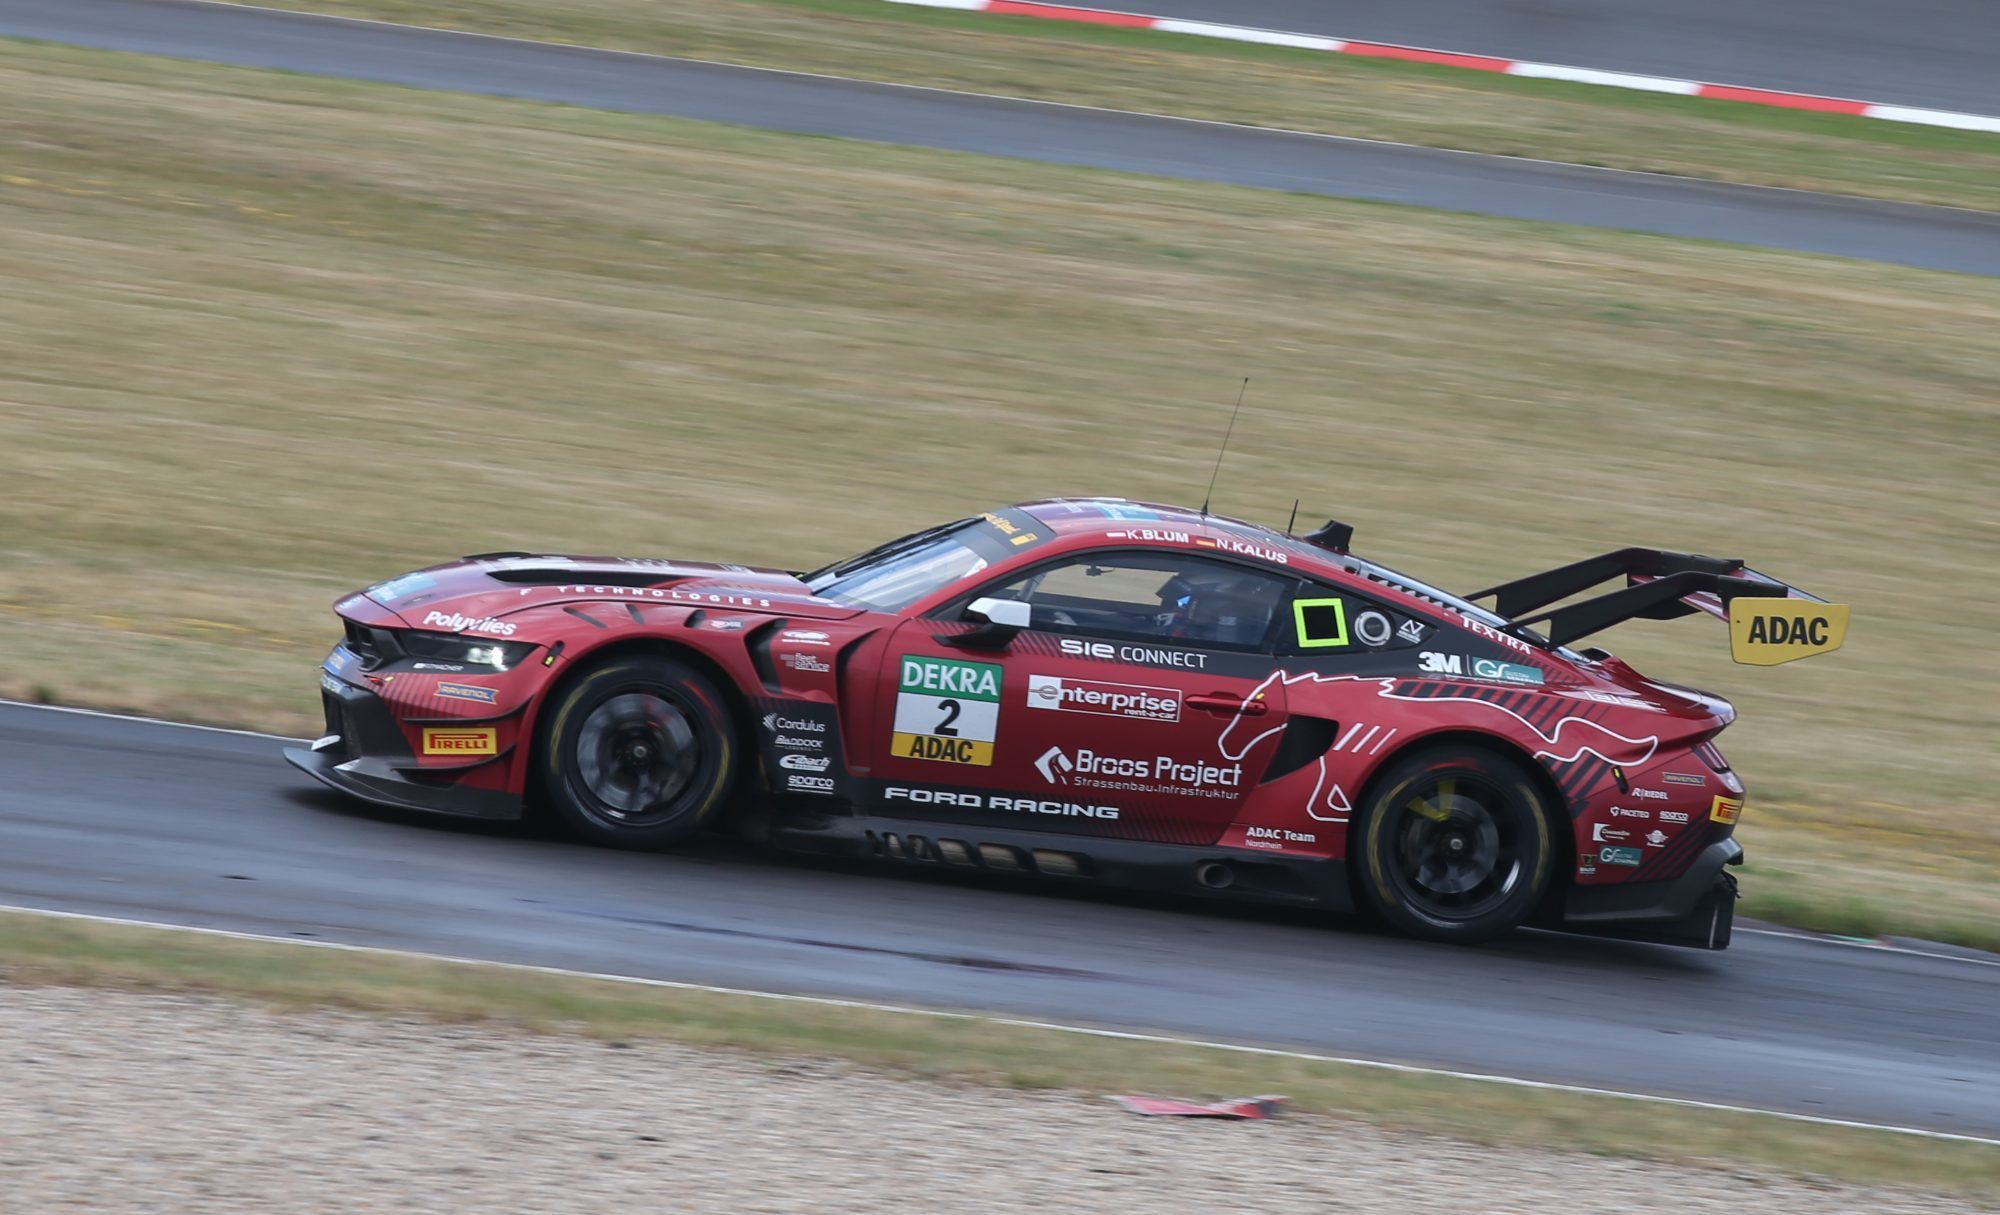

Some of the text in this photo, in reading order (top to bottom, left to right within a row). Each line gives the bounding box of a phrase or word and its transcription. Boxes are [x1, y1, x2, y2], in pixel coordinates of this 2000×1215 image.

[1126, 529, 1287, 564] K.BLUM N.KALUS
[558, 585, 770, 607] TECHNOLOGIES
[1460, 615, 1531, 655] TEXTRA
[1747, 616, 1829, 646] ADAC
[1120, 646, 1207, 668] CONNECT
[1418, 651, 1462, 674] 3M
[902, 660, 998, 697] DEKRA
[1038, 685, 1178, 712] enterprise
[934, 699, 961, 736] 2
[1124, 708, 1176, 720] rent-a-car
[429, 733, 488, 749] PIRELLI
[910, 736, 973, 763] ADAC
[788, 775, 834, 788] sparco
[1076, 749, 1242, 787] Broos Project
[884, 787, 1120, 819] FORD RACING
[1246, 826, 1316, 843] ADAC Team
